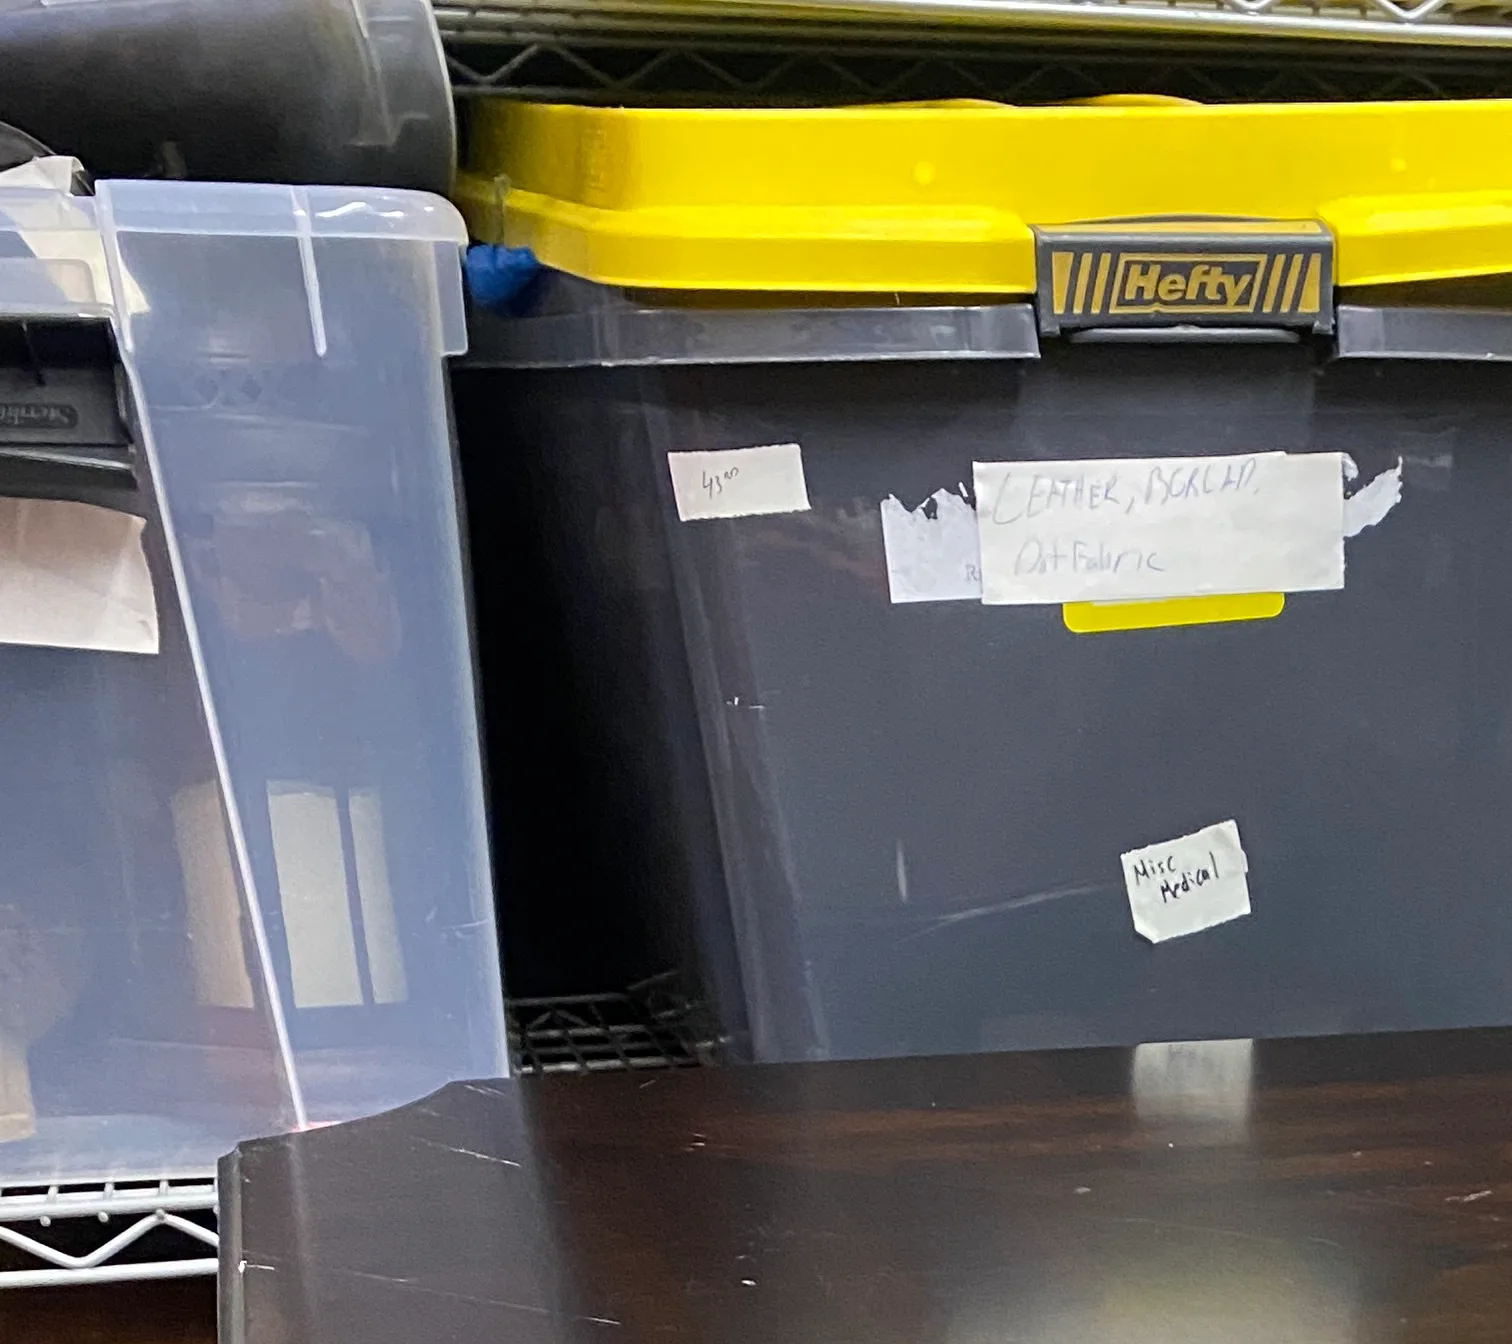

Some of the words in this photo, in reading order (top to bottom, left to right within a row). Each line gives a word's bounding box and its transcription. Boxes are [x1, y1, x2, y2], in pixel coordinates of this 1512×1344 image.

[1124, 263, 1253, 308] Hefty
[1072, 539, 1166, 575] Fabric
[1133, 855, 1177, 887] Misc
[1160, 850, 1220, 904] Medical
